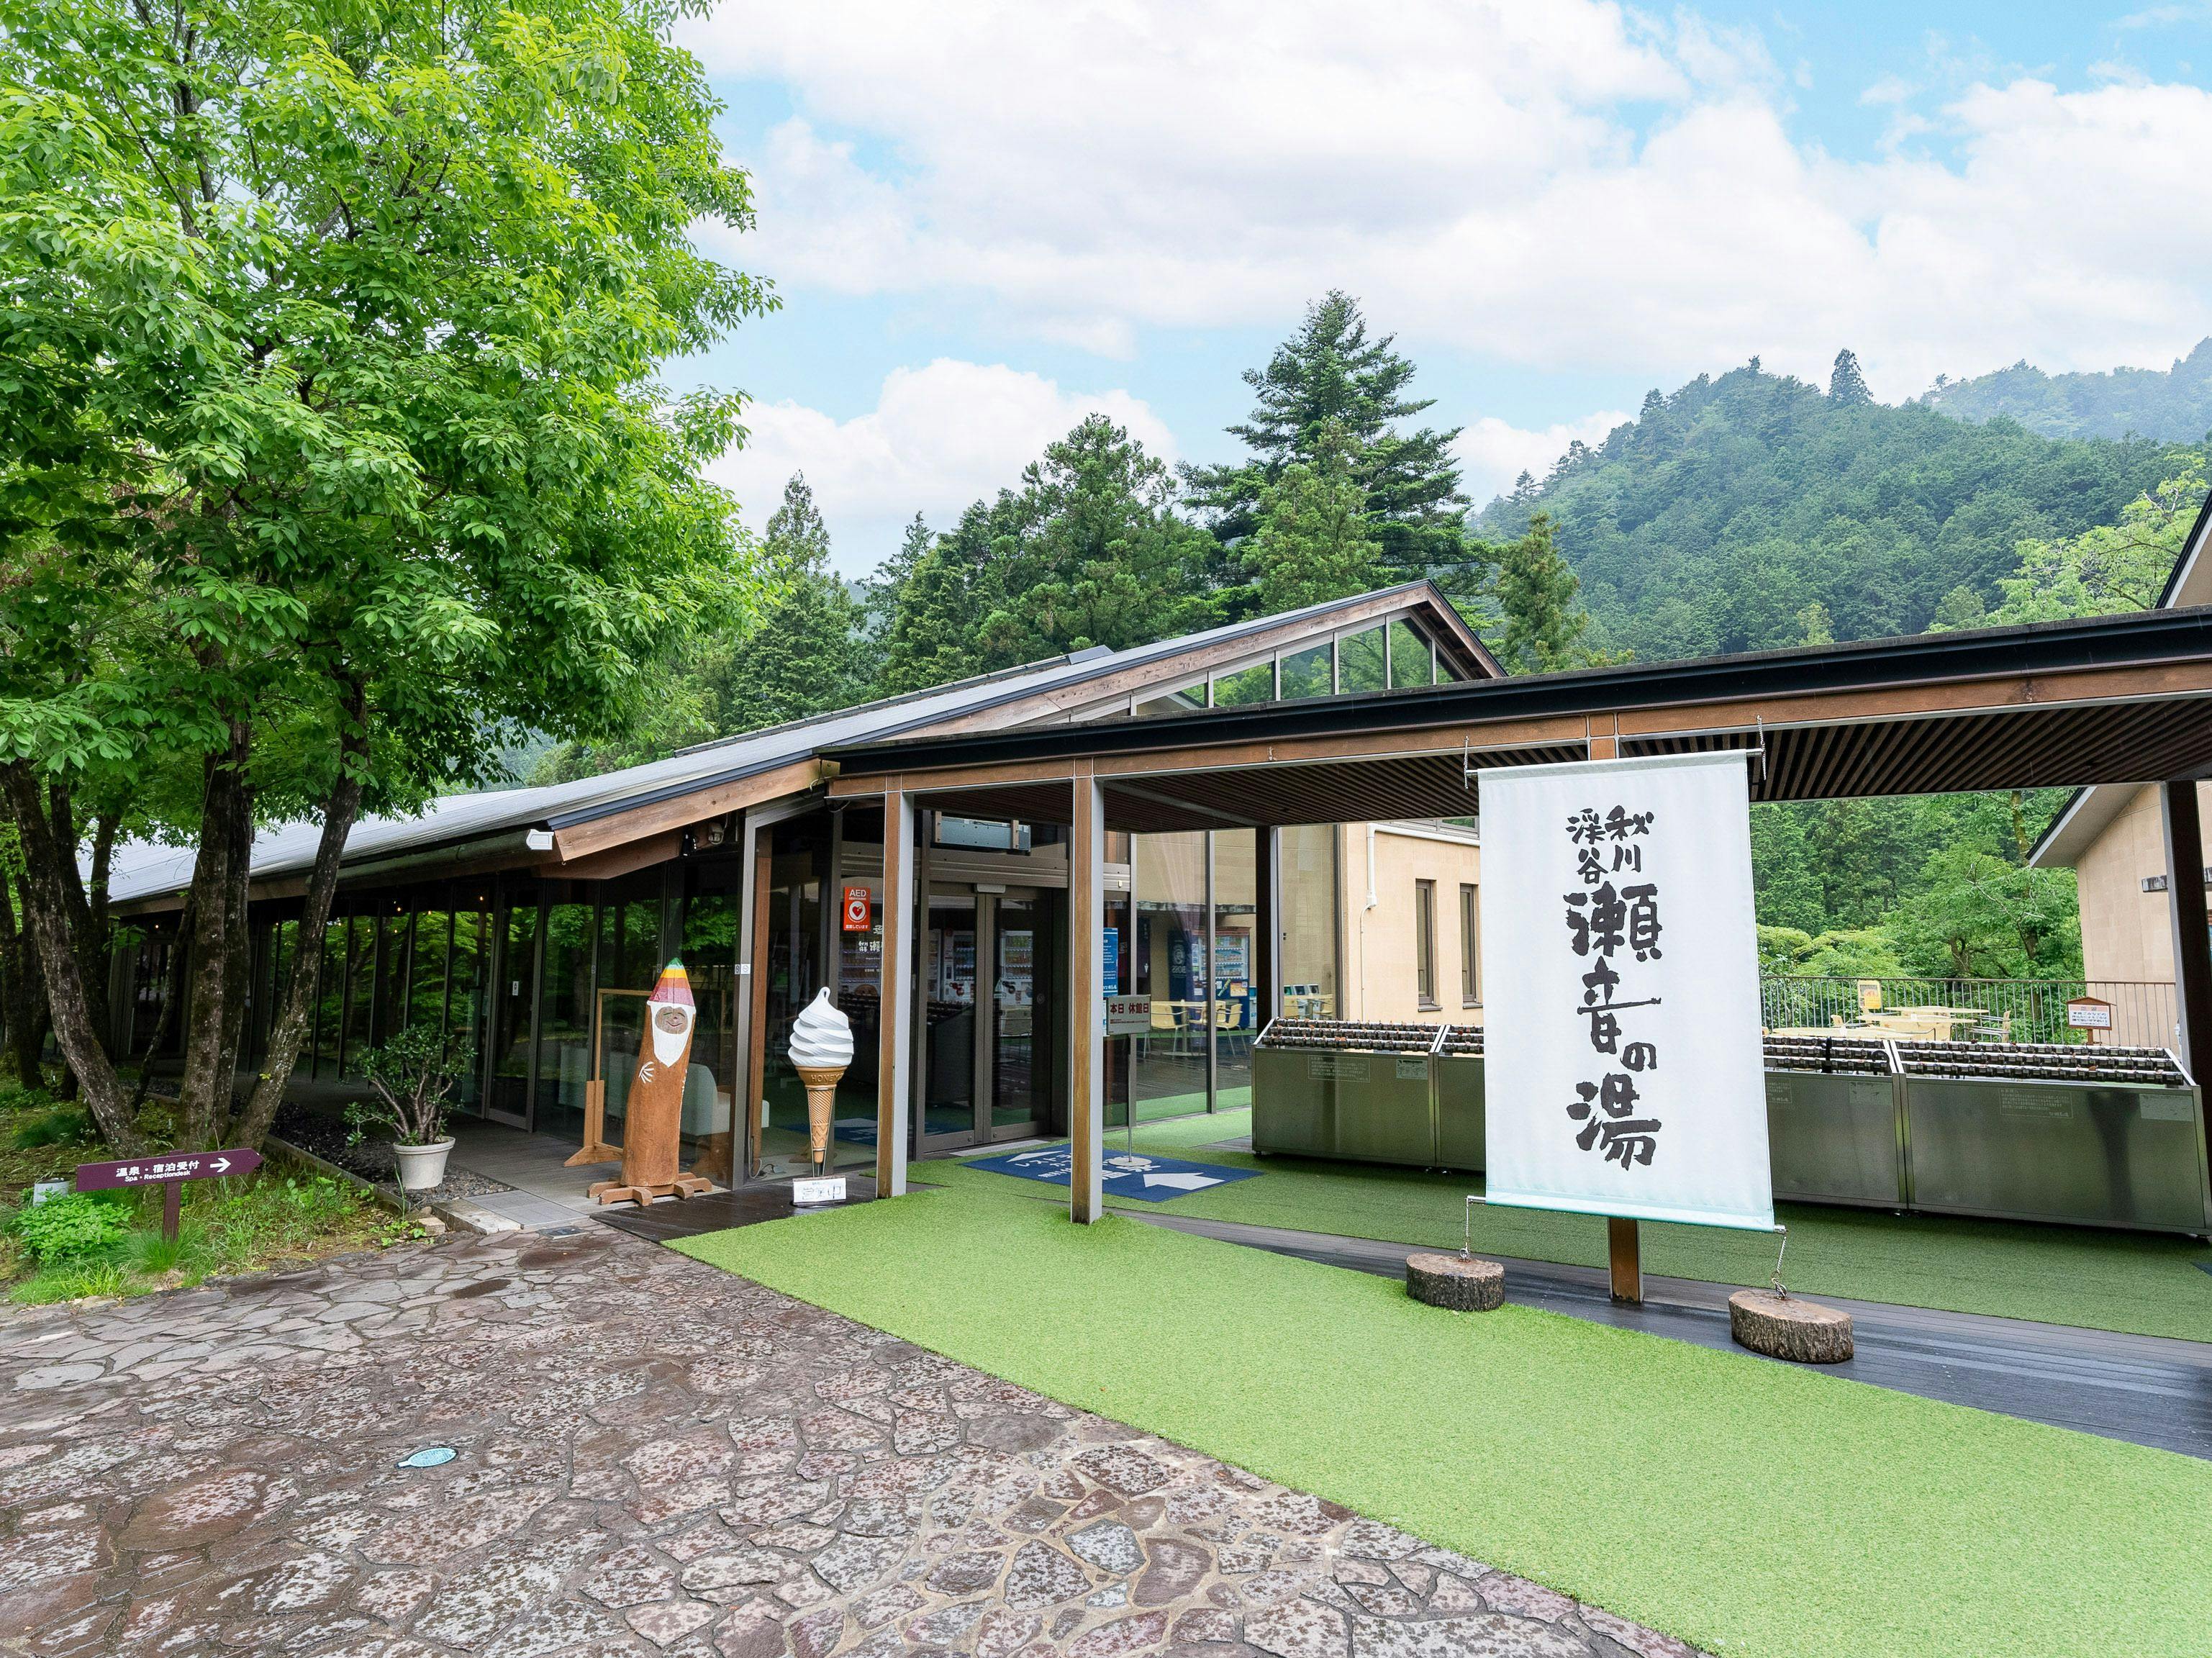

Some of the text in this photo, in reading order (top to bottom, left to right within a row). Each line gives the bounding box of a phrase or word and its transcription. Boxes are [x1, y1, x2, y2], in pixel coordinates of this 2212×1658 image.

[1604, 805, 1655, 874] 秋川
[1110, 1002, 1149, 1015] 本日 休館日
[1562, 880, 1664, 1172] 瀬音の湯
[116, 1160, 200, 1177] 温泉・宿泊受付
[1015, 1153, 1071, 1167] レストラ
